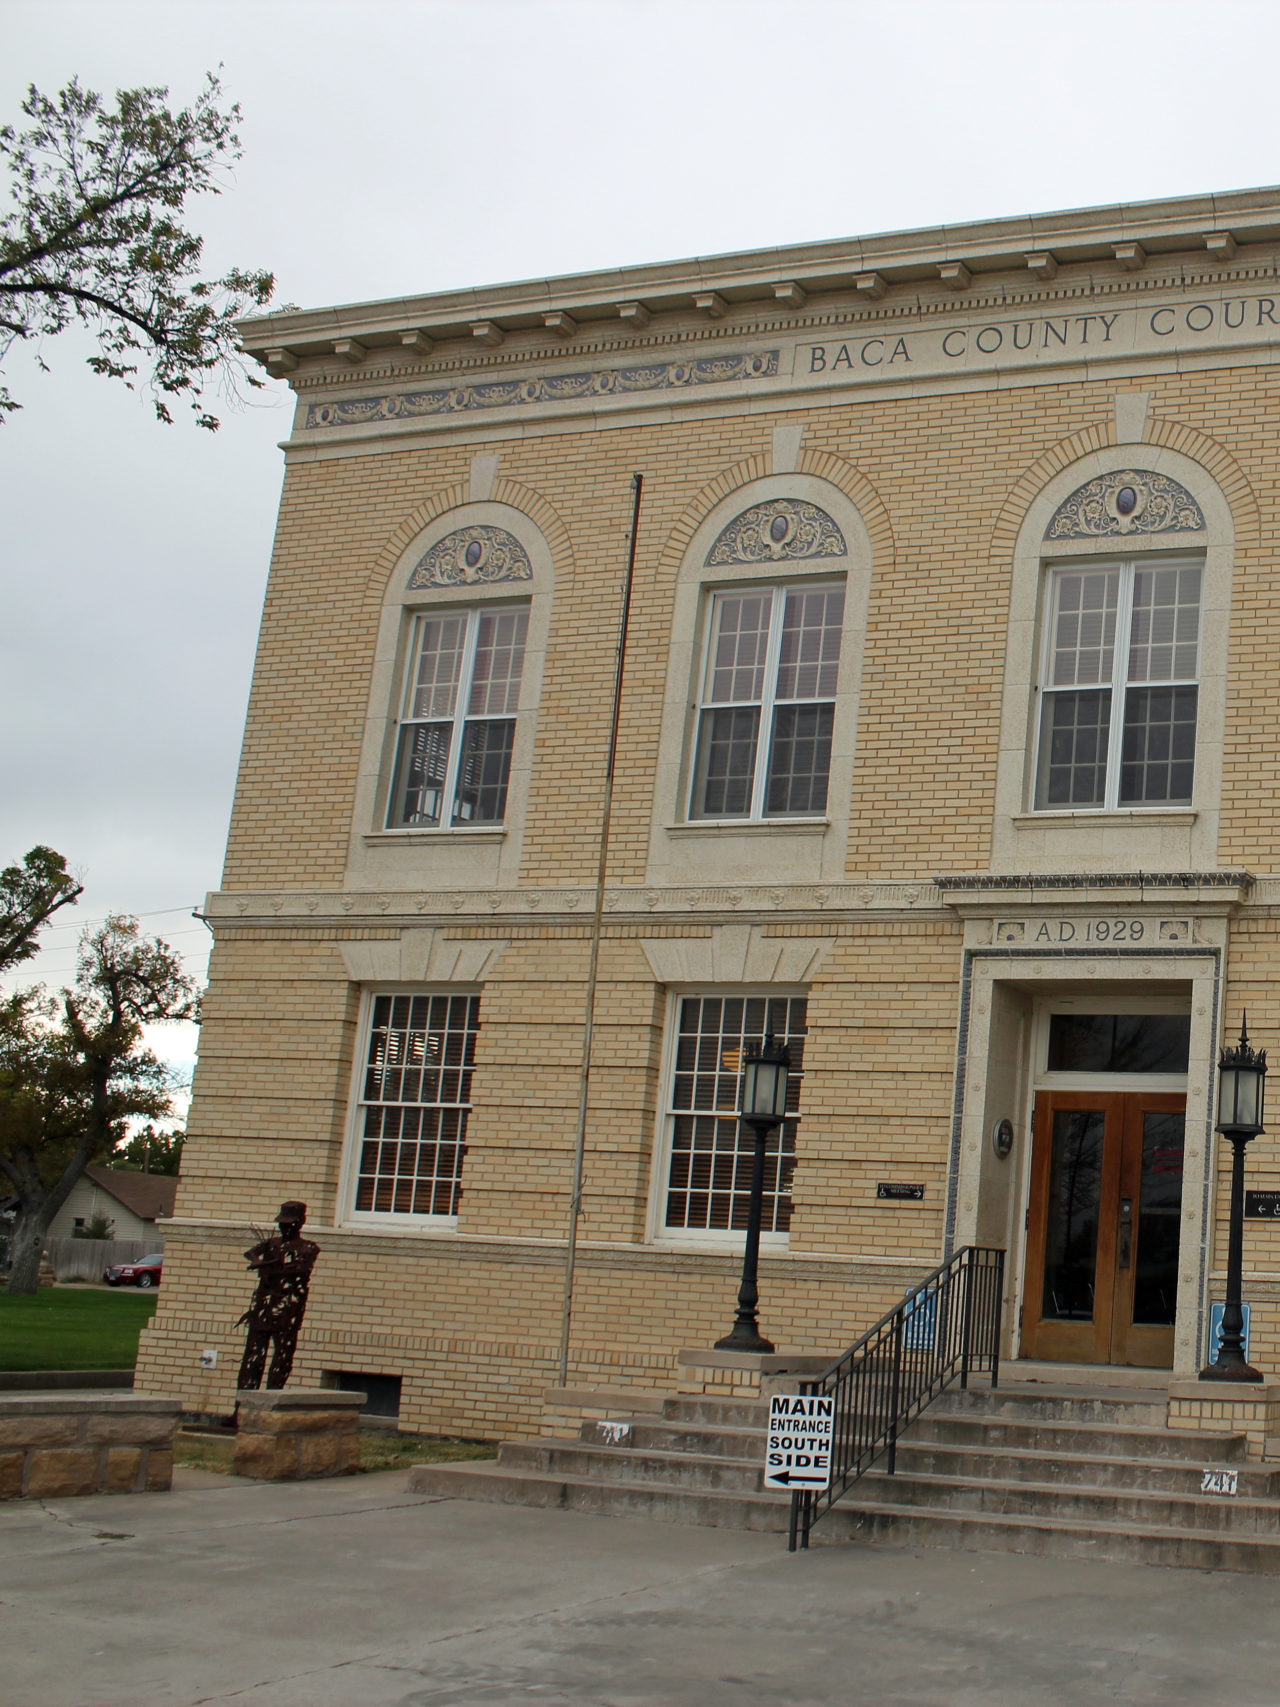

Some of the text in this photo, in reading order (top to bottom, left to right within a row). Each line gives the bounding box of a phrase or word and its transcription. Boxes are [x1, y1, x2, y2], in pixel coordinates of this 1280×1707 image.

[808, 337, 912, 373] BACA
[942, 313, 1121, 357] COUNTY
[1034, 920, 1145, 942] A.D. 1929
[771, 1397, 833, 1417] MAIN
[770, 1418, 831, 1434] ENTRANCE
[769, 1436, 830, 1452] SOUTH
[768, 1453, 829, 1468] SIDE
